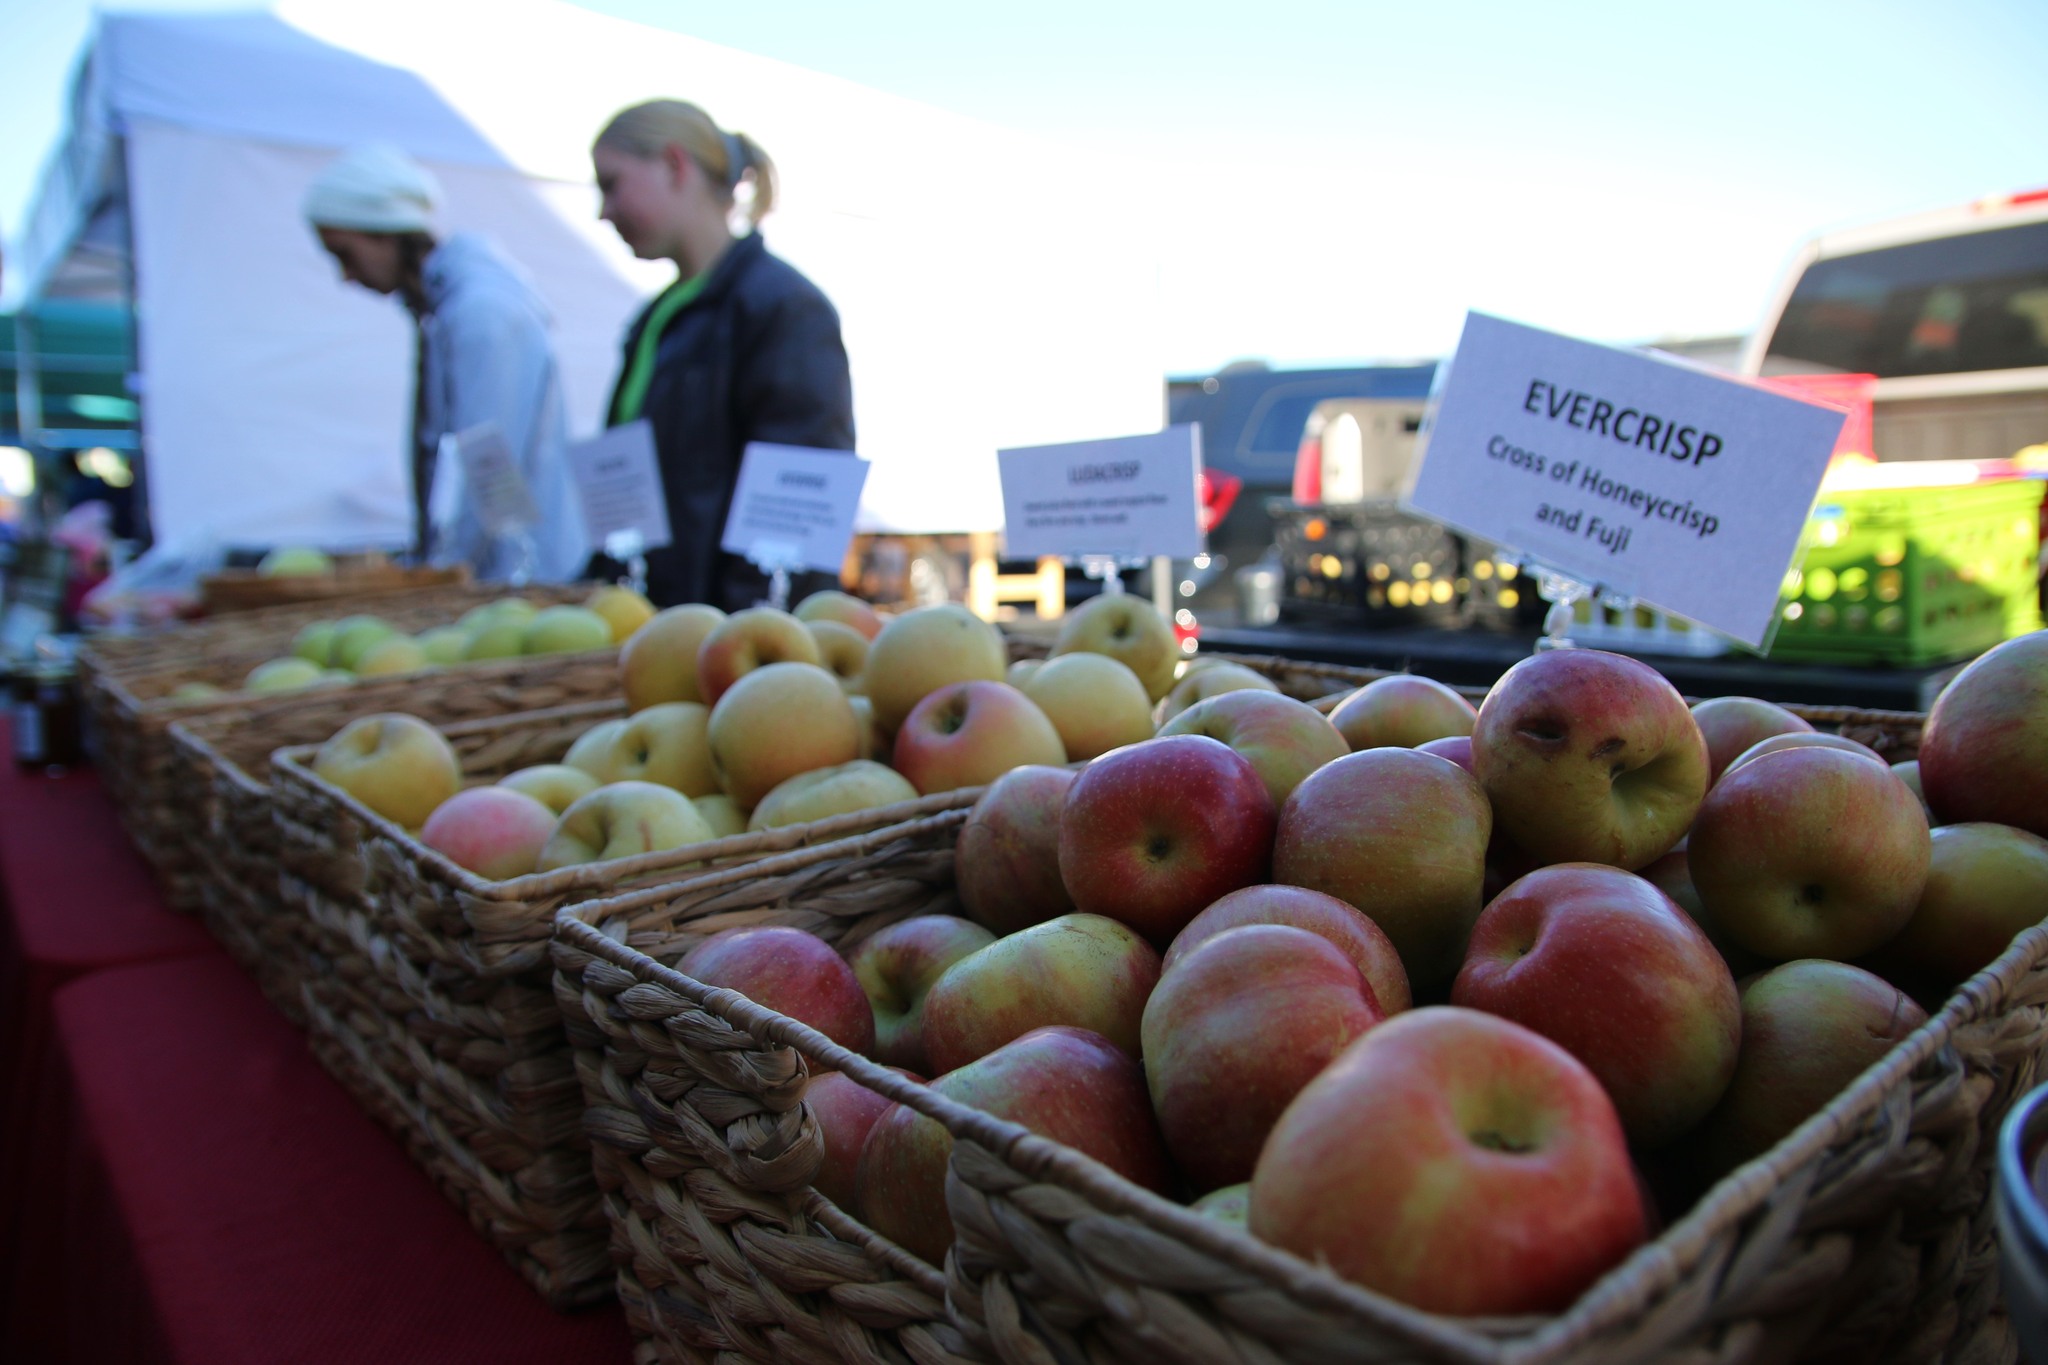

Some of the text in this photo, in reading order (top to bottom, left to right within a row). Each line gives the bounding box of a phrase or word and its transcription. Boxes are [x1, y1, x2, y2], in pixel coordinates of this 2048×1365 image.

[1523, 377, 1723, 467] EVERCRISP
[1488, 434, 1720, 538] Cross of Honeycrisp
[1536, 503, 1633, 554] and Fuji
